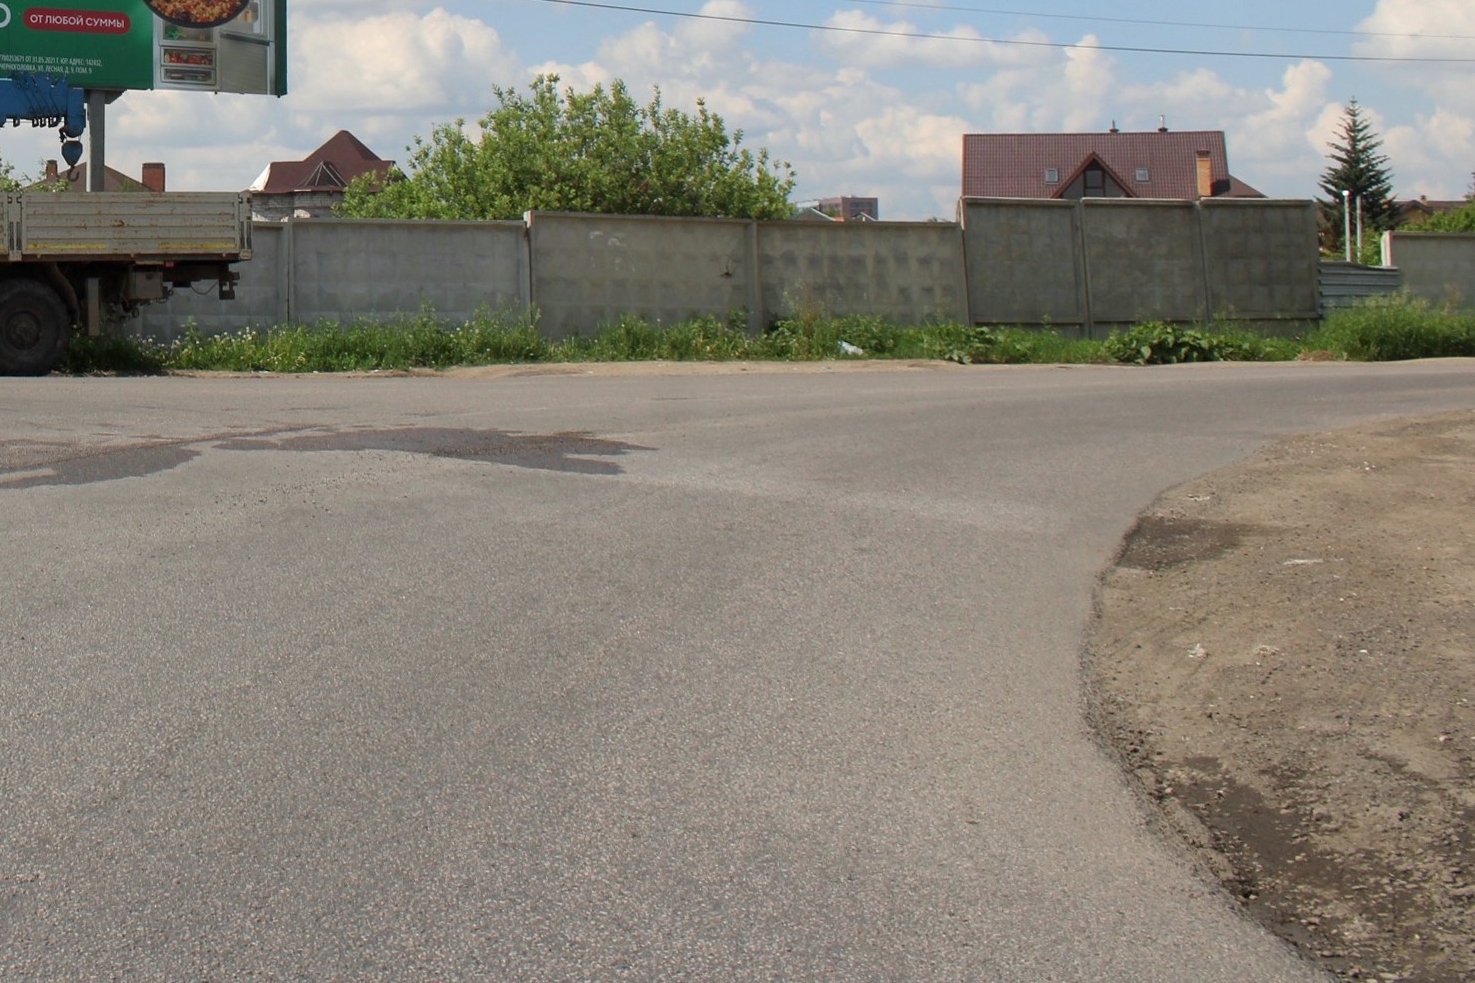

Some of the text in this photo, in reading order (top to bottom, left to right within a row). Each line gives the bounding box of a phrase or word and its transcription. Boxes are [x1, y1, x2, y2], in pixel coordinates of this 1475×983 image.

[30, 14, 125, 28] ОТ ЛЮБОЙ СУММЫ
